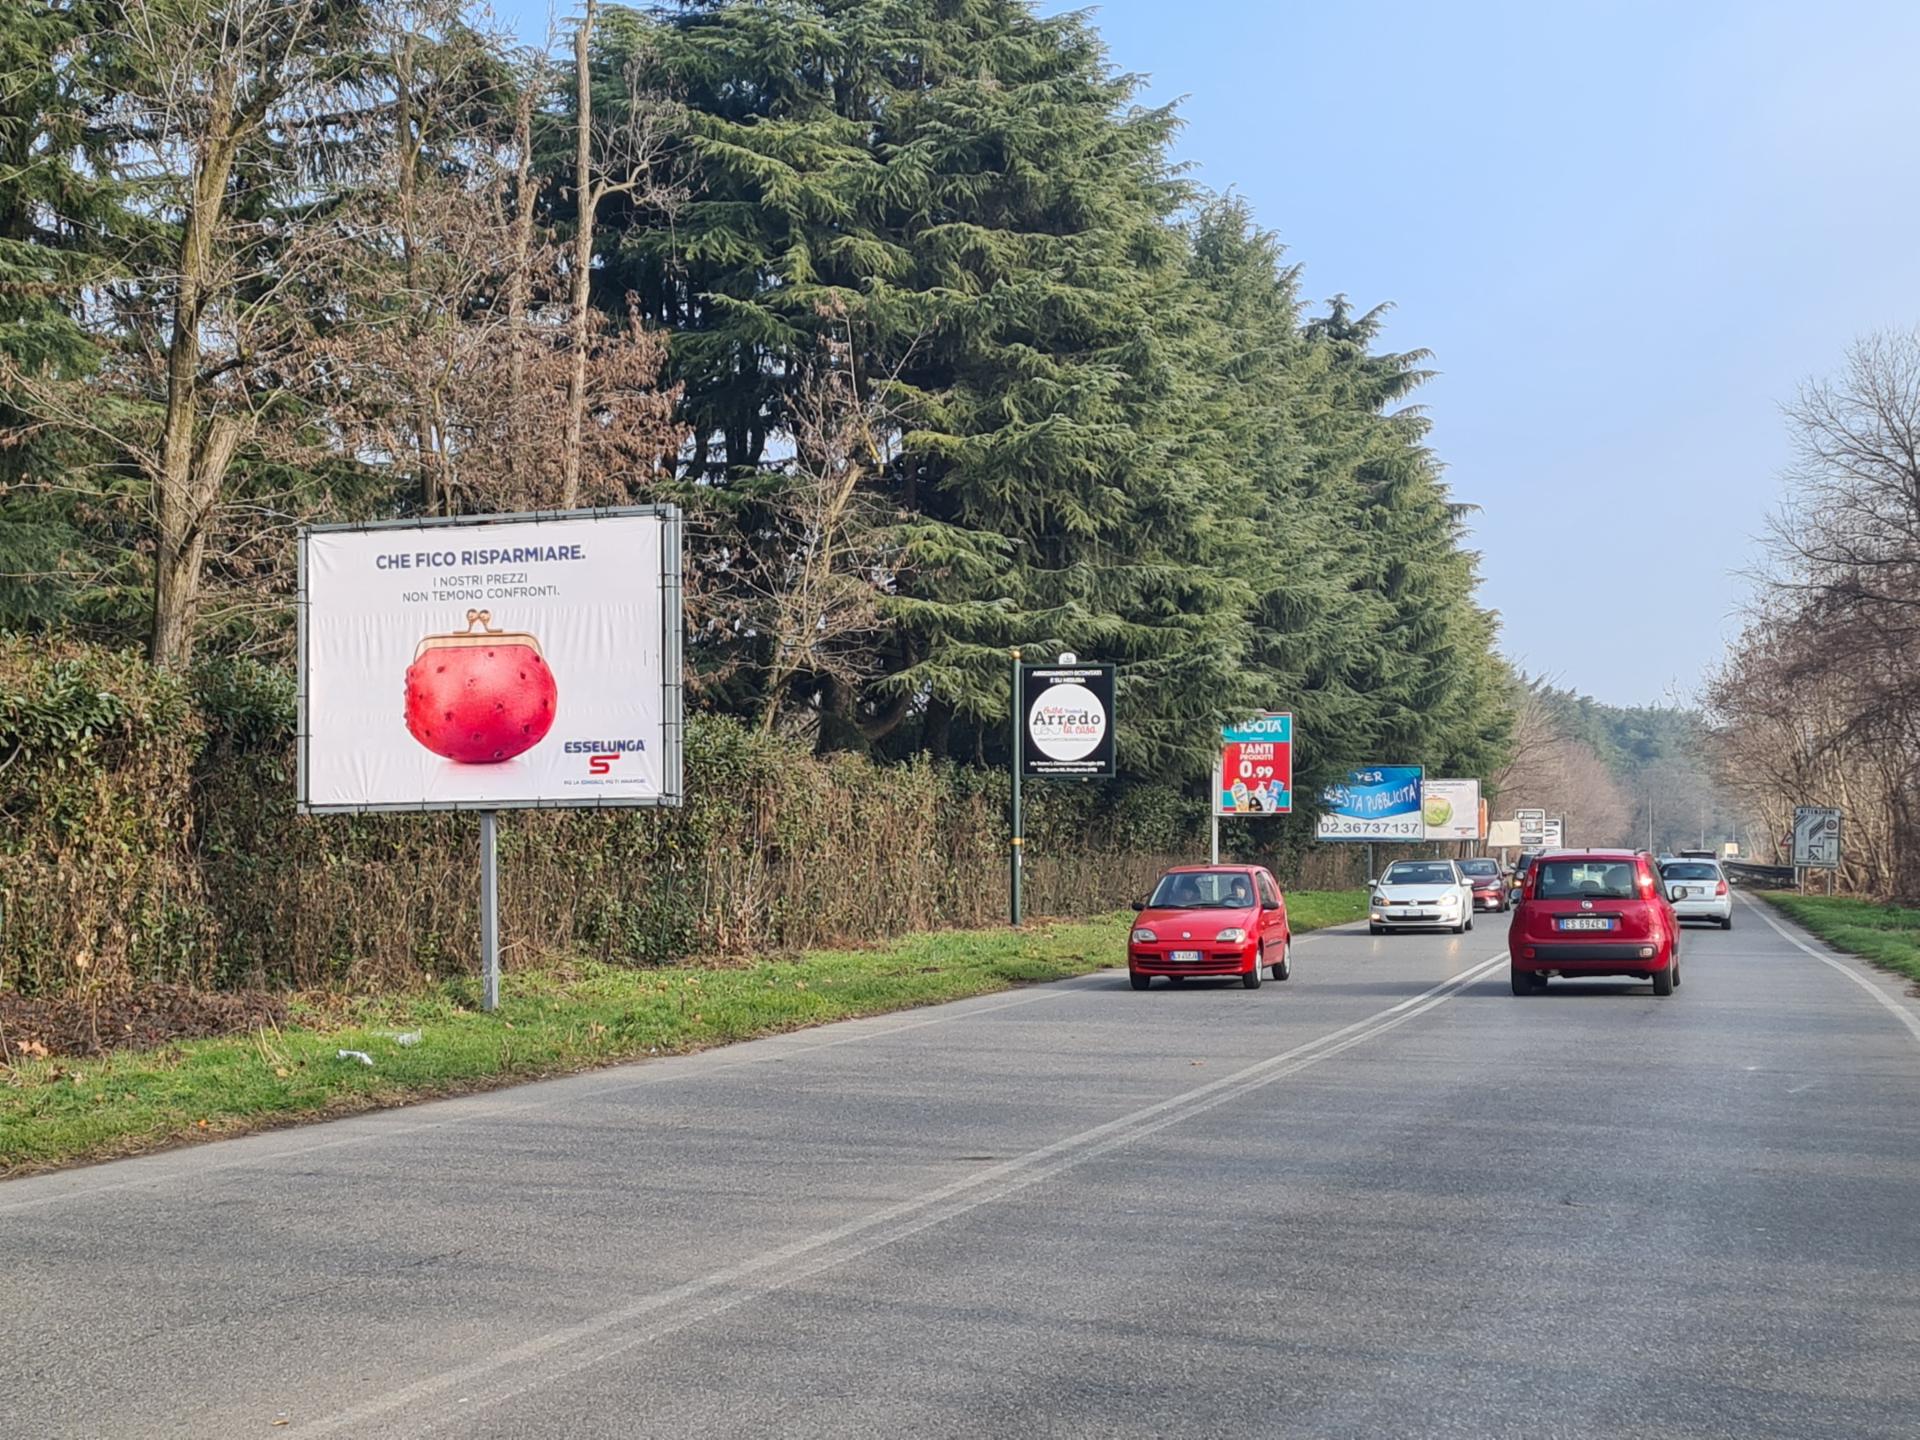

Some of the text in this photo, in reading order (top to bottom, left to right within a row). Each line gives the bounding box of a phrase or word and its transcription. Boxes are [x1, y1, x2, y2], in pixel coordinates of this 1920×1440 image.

[376, 545, 587, 570] CHE FICO RISPARMIARE.
[440, 575, 483, 587] NOSTRI
[486, 573, 528, 585] PREZZI
[402, 585, 561, 603] NON TEMONO CONFRONTI.
[1032, 711, 1101, 726] Arredo
[1075, 725, 1096, 734] casa
[564, 739, 646, 754] ESSELUNGA
[1239, 743, 1274, 754] TANTI
[1239, 761, 1274, 778] 0.99
[1321, 822, 1419, 834] 02.36737137
